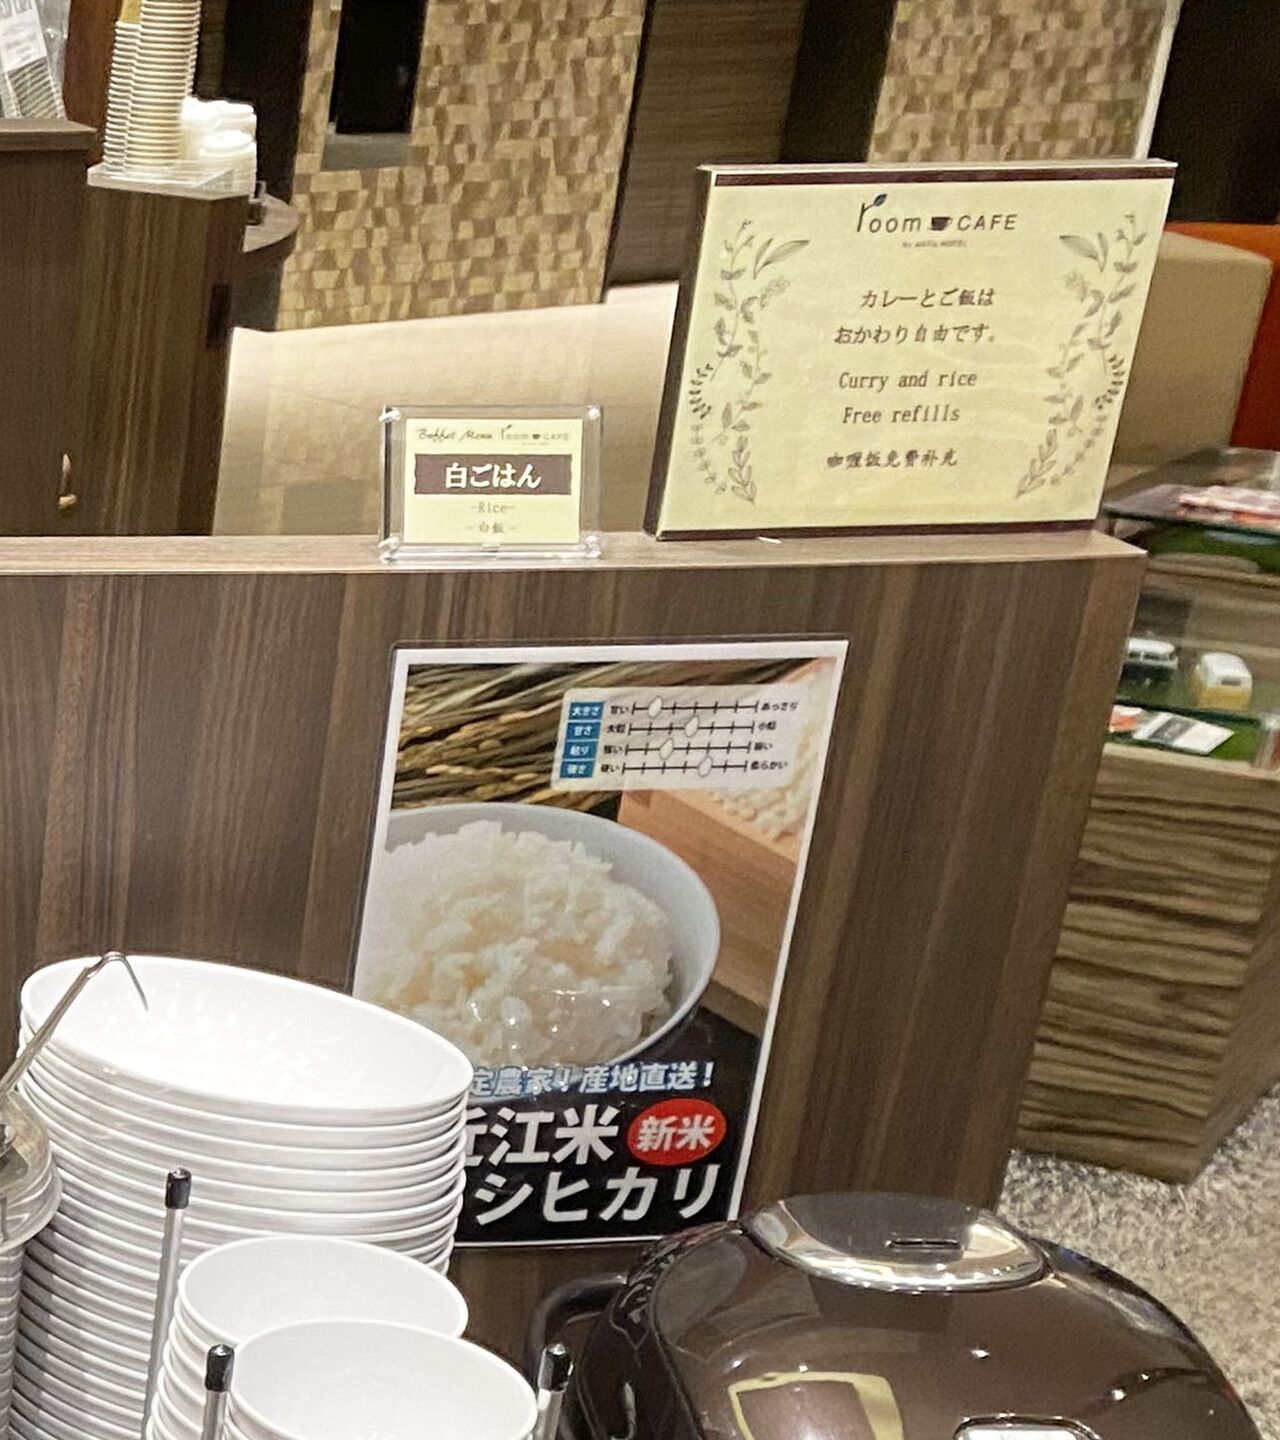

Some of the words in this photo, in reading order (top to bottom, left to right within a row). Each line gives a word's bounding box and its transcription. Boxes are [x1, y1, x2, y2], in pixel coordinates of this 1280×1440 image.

[857, 194, 922, 233] room
[957, 214, 1018, 232] CAFE
[861, 288, 996, 308] カレーとご飯は
[834, 323, 995, 344] おかわり自由です。
[839, 371, 889, 393] Curry
[898, 369, 929, 388] and
[938, 370, 978, 387] rice
[842, 406, 882, 424] Free
[891, 404, 961, 423] refills
[444, 462, 542, 489] 白ごはん
[637, 1113, 716, 1151] 新米
